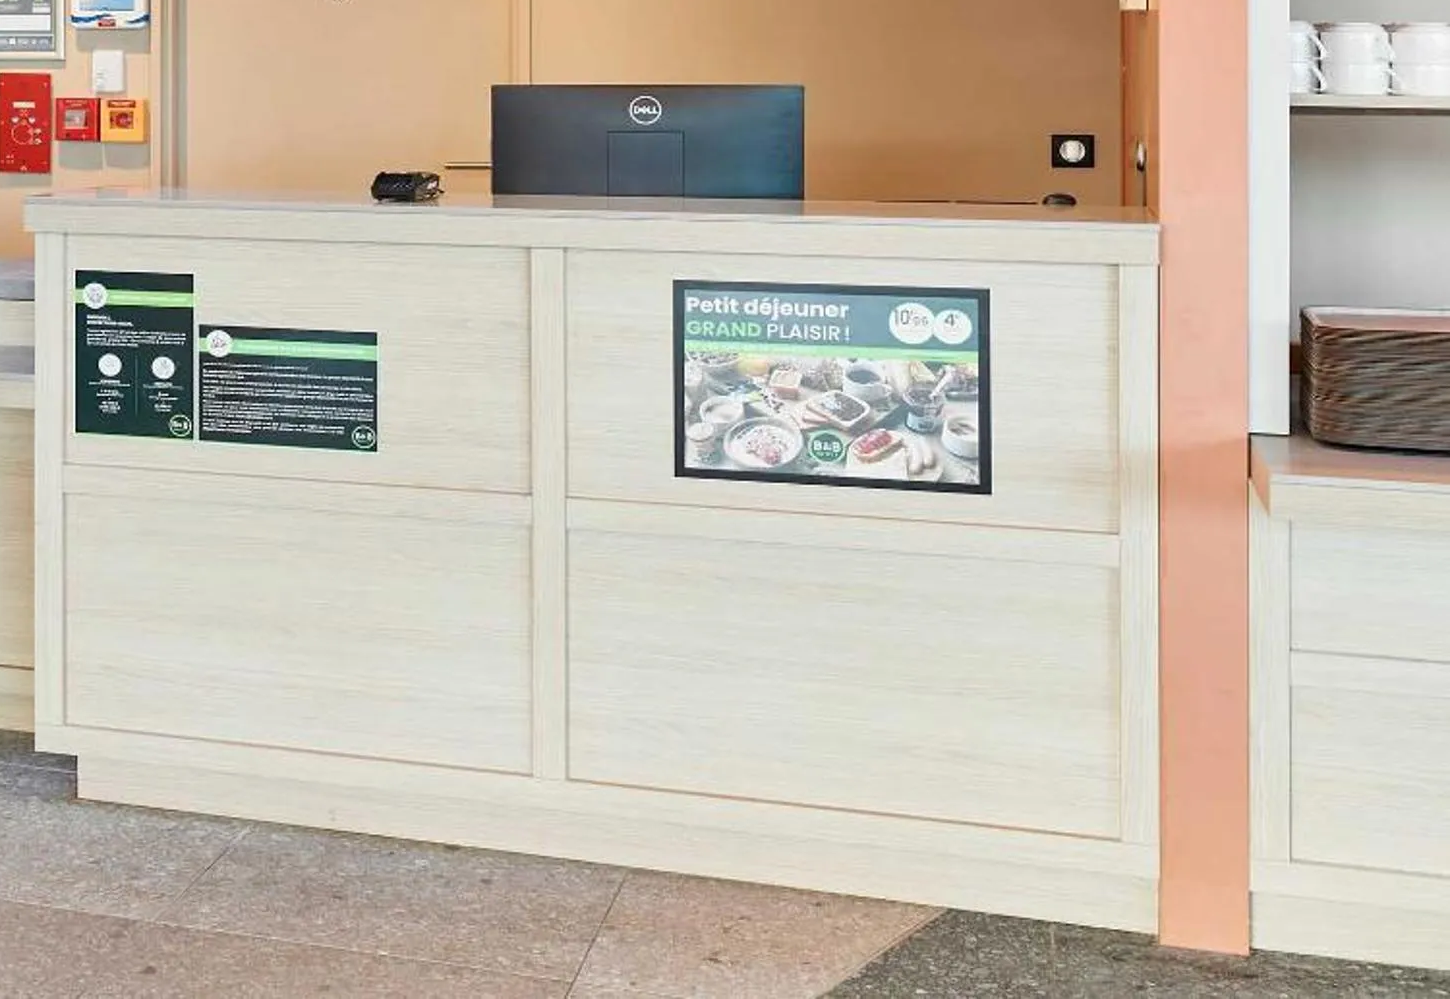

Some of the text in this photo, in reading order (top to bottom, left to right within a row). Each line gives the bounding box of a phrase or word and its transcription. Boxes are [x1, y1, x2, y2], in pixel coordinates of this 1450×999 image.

[633, 105, 659, 115] DELL
[685, 296, 850, 321] Petit déjeuner
[686, 319, 762, 337] GRAND
[766, 323, 841, 341] PLAISIR
